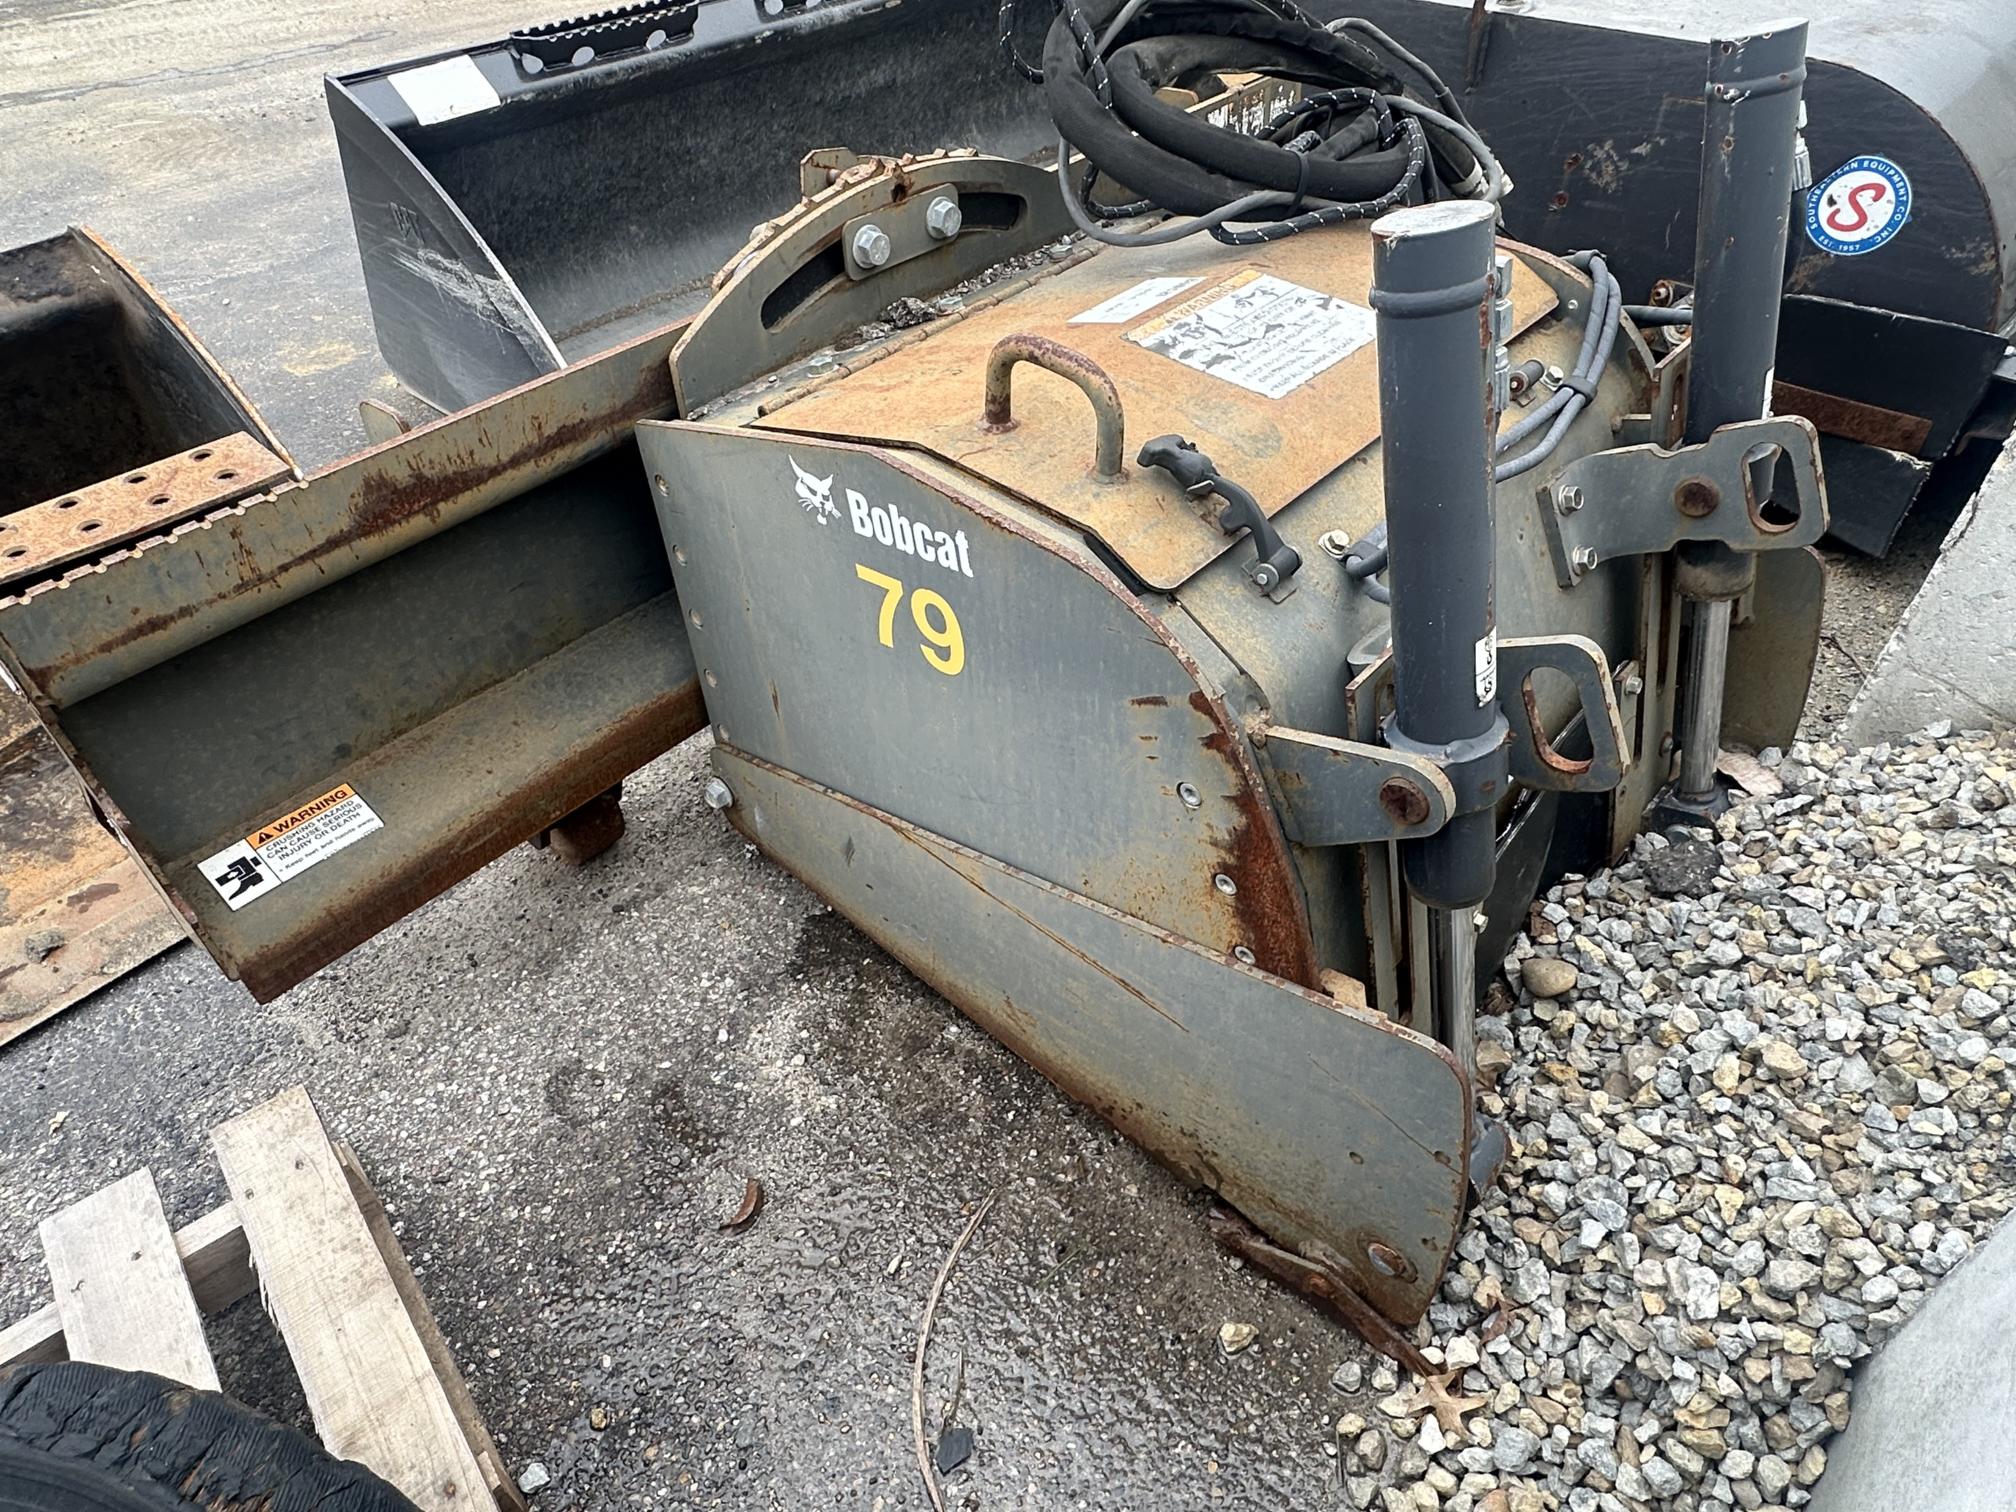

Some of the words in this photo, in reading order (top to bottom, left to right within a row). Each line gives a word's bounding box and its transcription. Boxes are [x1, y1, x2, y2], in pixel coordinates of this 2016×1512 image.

[1863, 160, 1906, 201] EQUIPMENT
[1827, 183, 1886, 232] S
[845, 487, 973, 578] Bobcat
[855, 563, 965, 676] 79
[265, 822, 316, 852] CRUSHING
[317, 800, 354, 823] HAZARD
[267, 846, 288, 859] CAN
[289, 827, 320, 847] CAUSE
[323, 803, 362, 828] SERIOUS
[272, 788, 348, 834] WARNING
[278, 840, 313, 861] INJURY
[314, 830, 328, 840] OR
[330, 812, 360, 831] DEATH
